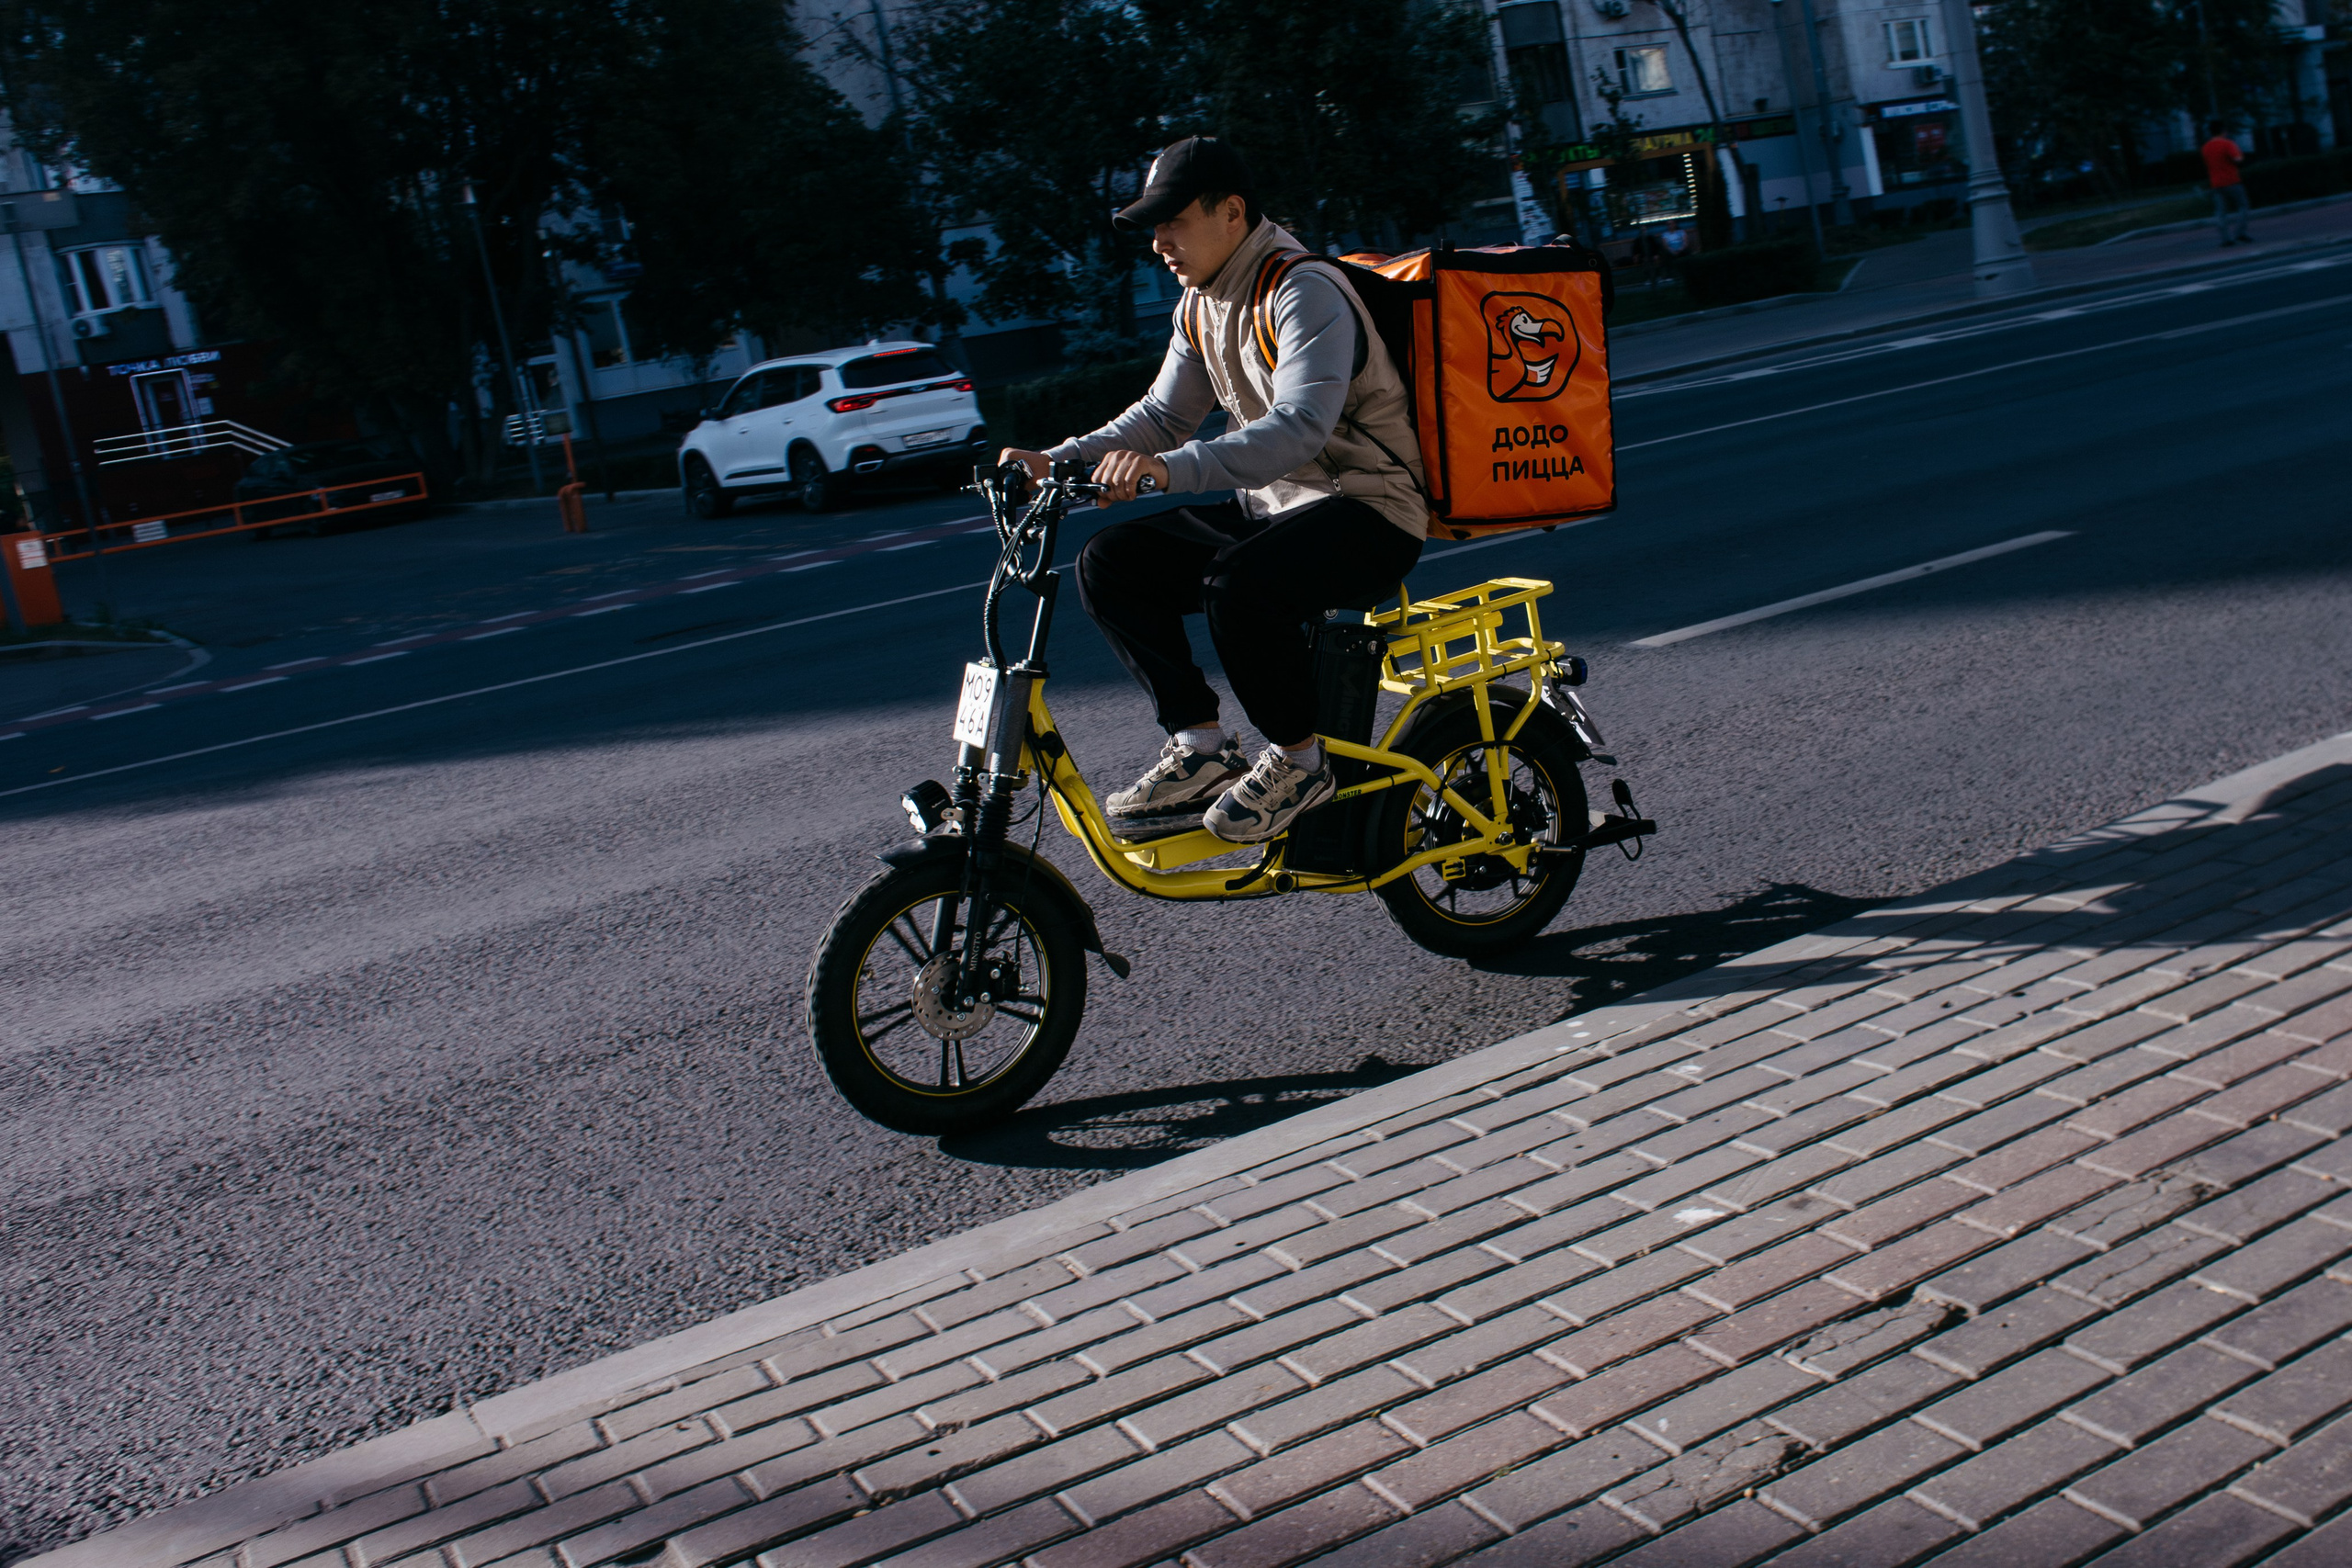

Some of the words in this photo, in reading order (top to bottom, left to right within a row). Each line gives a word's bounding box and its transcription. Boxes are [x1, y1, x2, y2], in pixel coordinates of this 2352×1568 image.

[1493, 424, 1568, 452] ДОДО
[1493, 457, 1584, 482] ПИЦЦА
[1333, 789, 1362, 800] MONSTER
[968, 931, 982, 971] MINGTO
